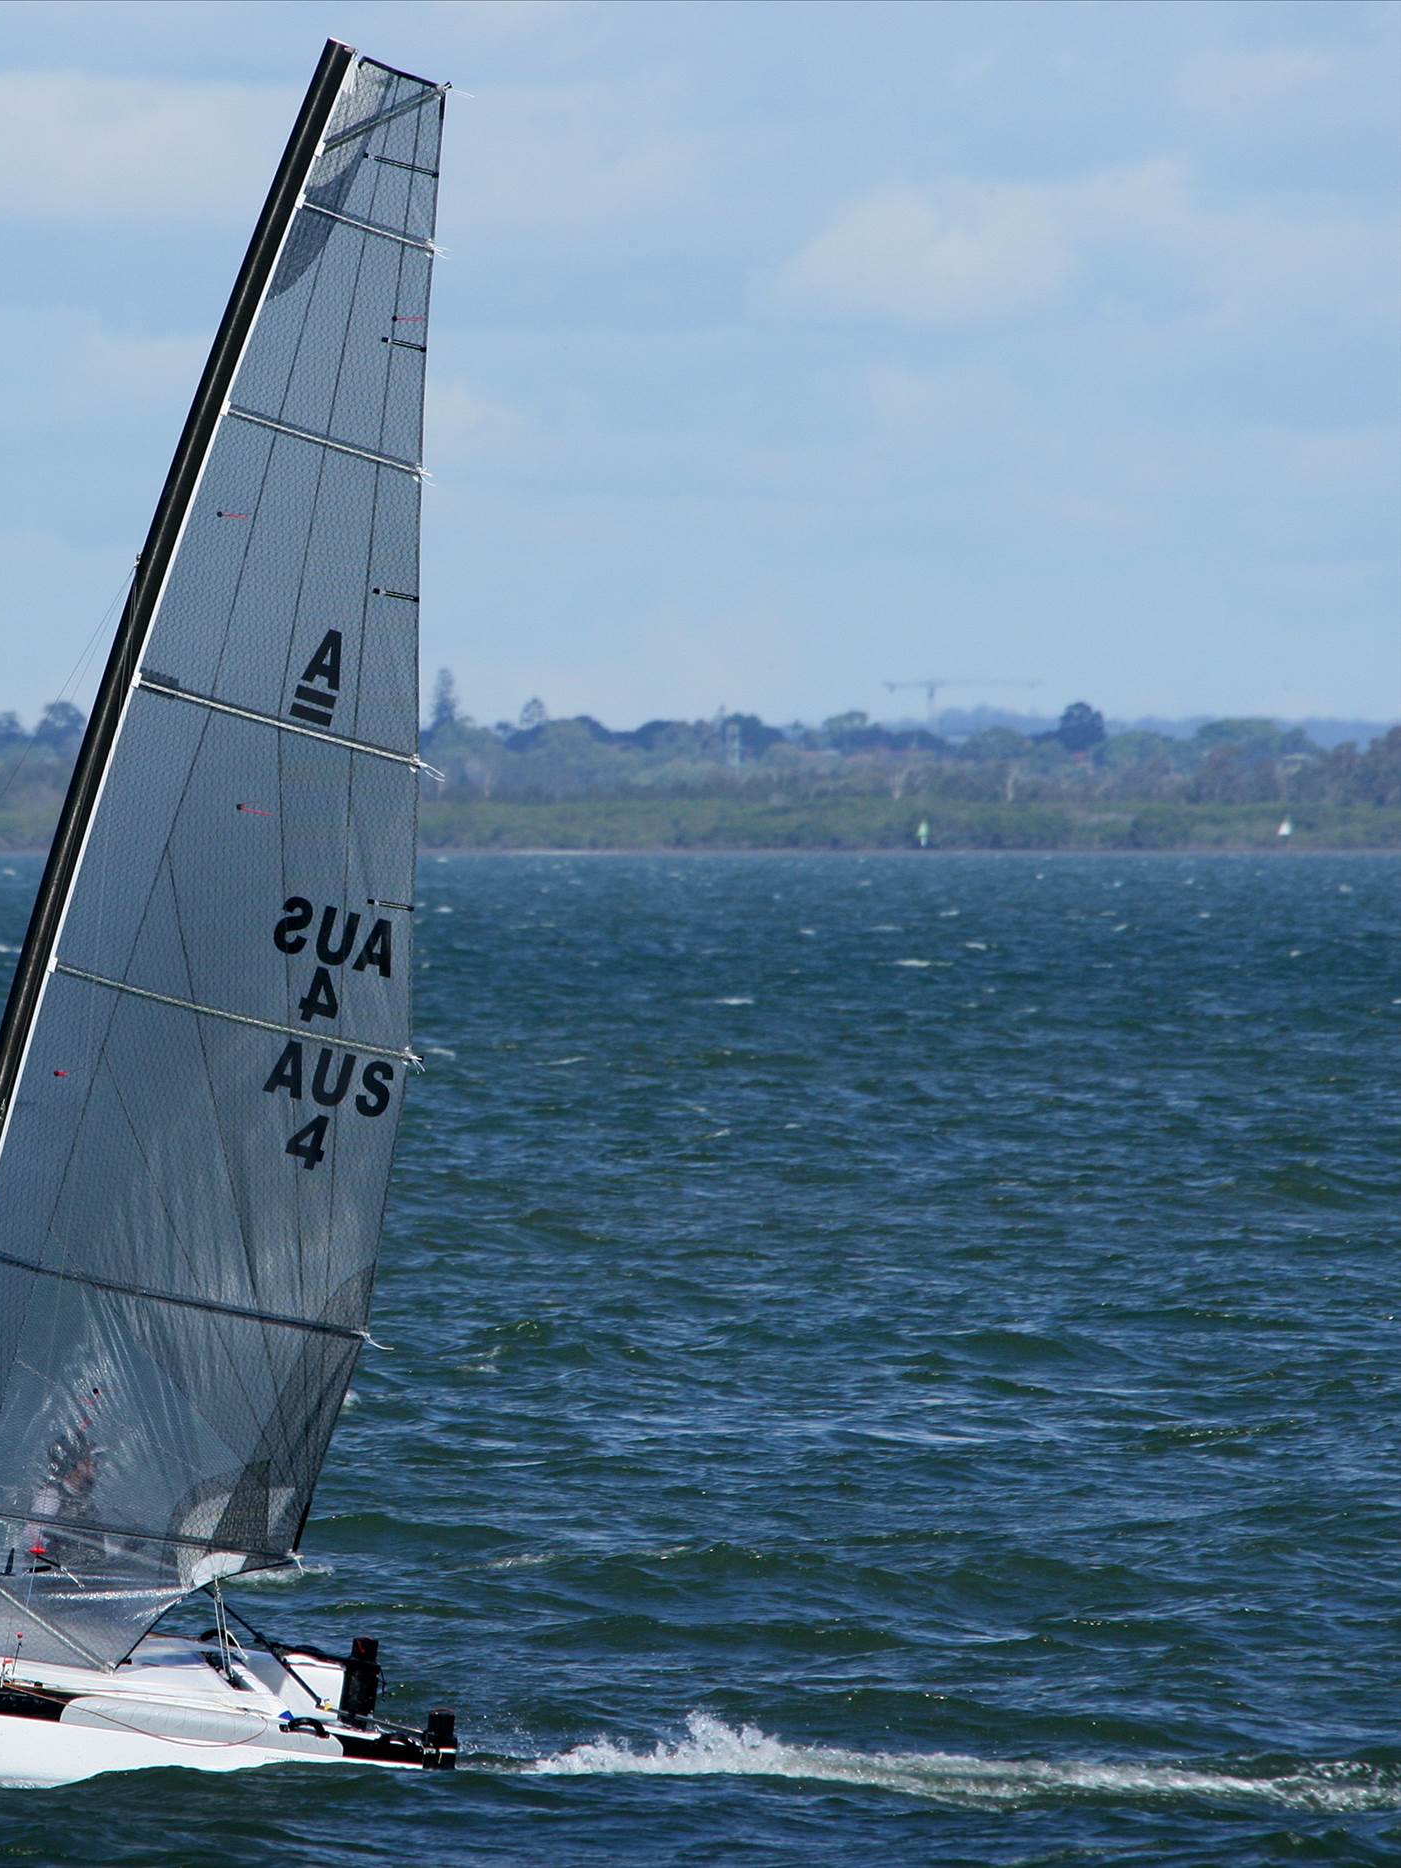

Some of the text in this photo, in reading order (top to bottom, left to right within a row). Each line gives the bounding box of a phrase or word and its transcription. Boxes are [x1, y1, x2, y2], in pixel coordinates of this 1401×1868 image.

[301, 629, 342, 691] A
[262, 1040, 394, 1118] AUS
[285, 1114, 329, 1170] 4
